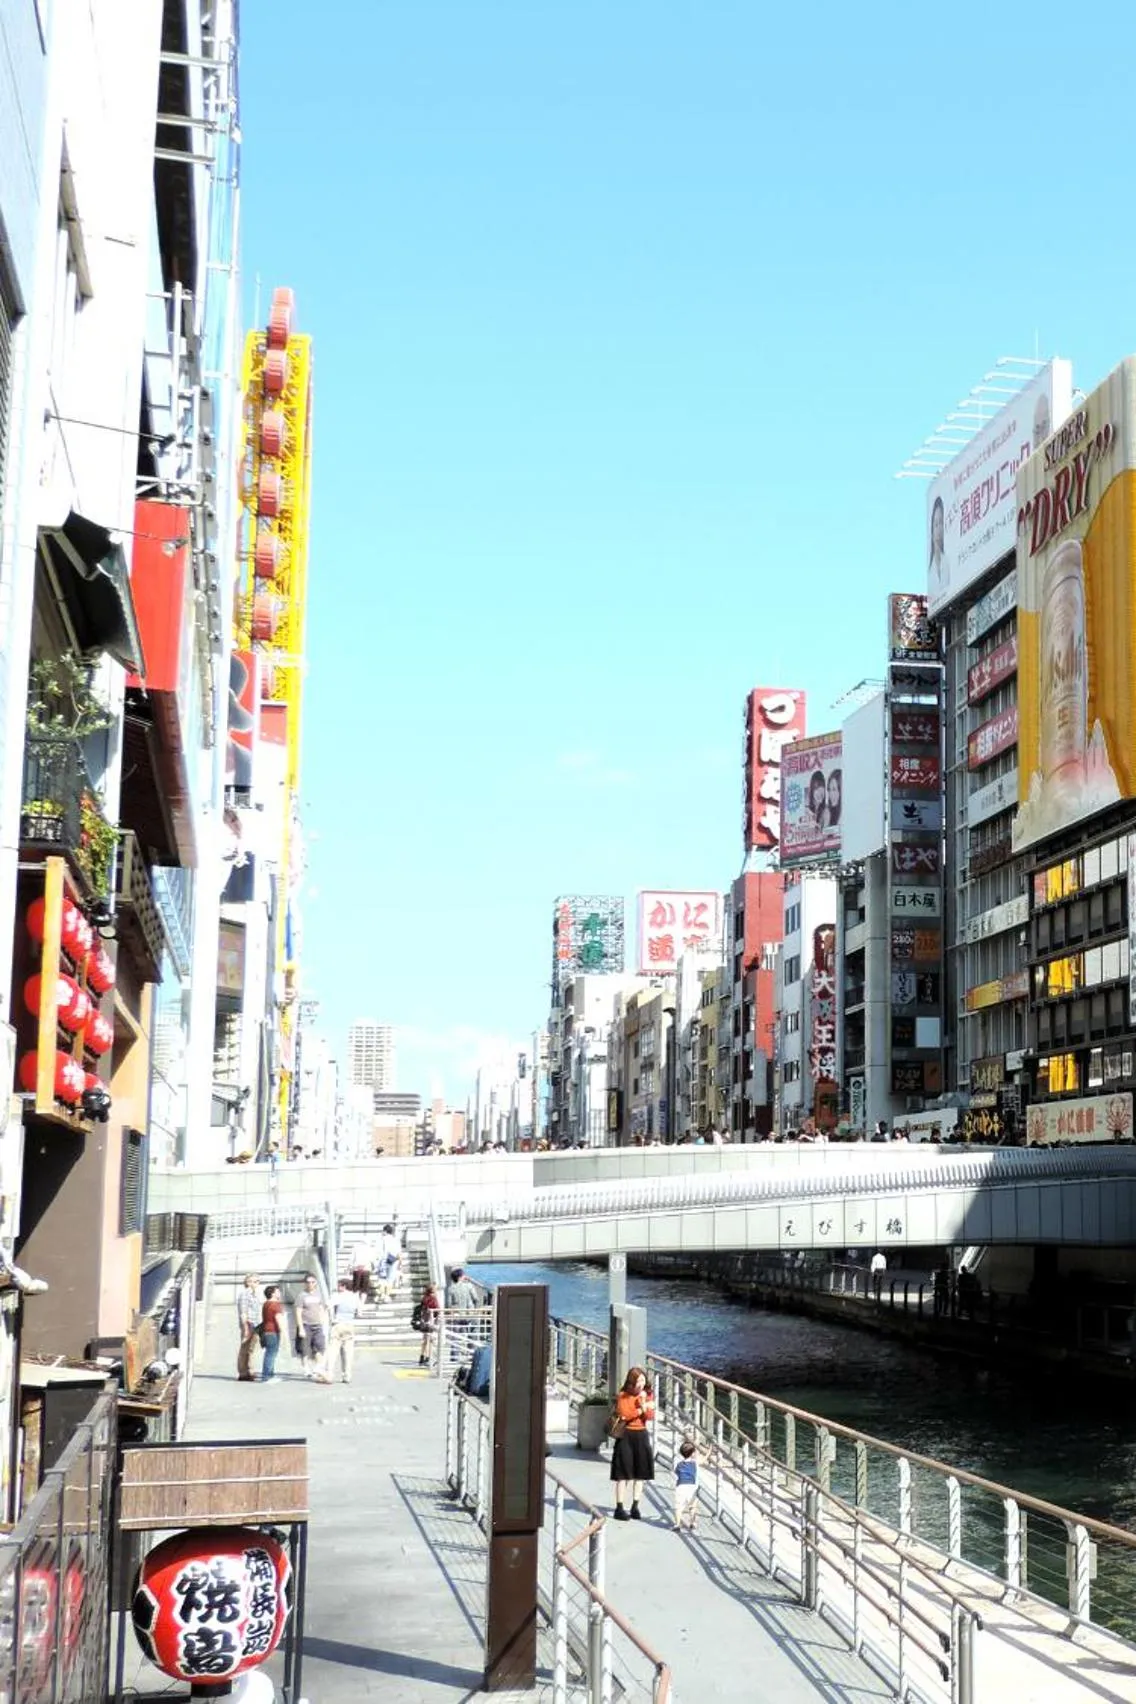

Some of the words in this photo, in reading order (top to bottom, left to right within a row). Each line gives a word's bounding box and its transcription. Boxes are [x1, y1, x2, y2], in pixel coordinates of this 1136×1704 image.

[1043, 411, 1087, 472] SUPER
[894, 890, 935, 908] 白木屋
[784, 1218, 903, 1237] えびす橋
[175, 1562, 241, 1675] 焼鳥
